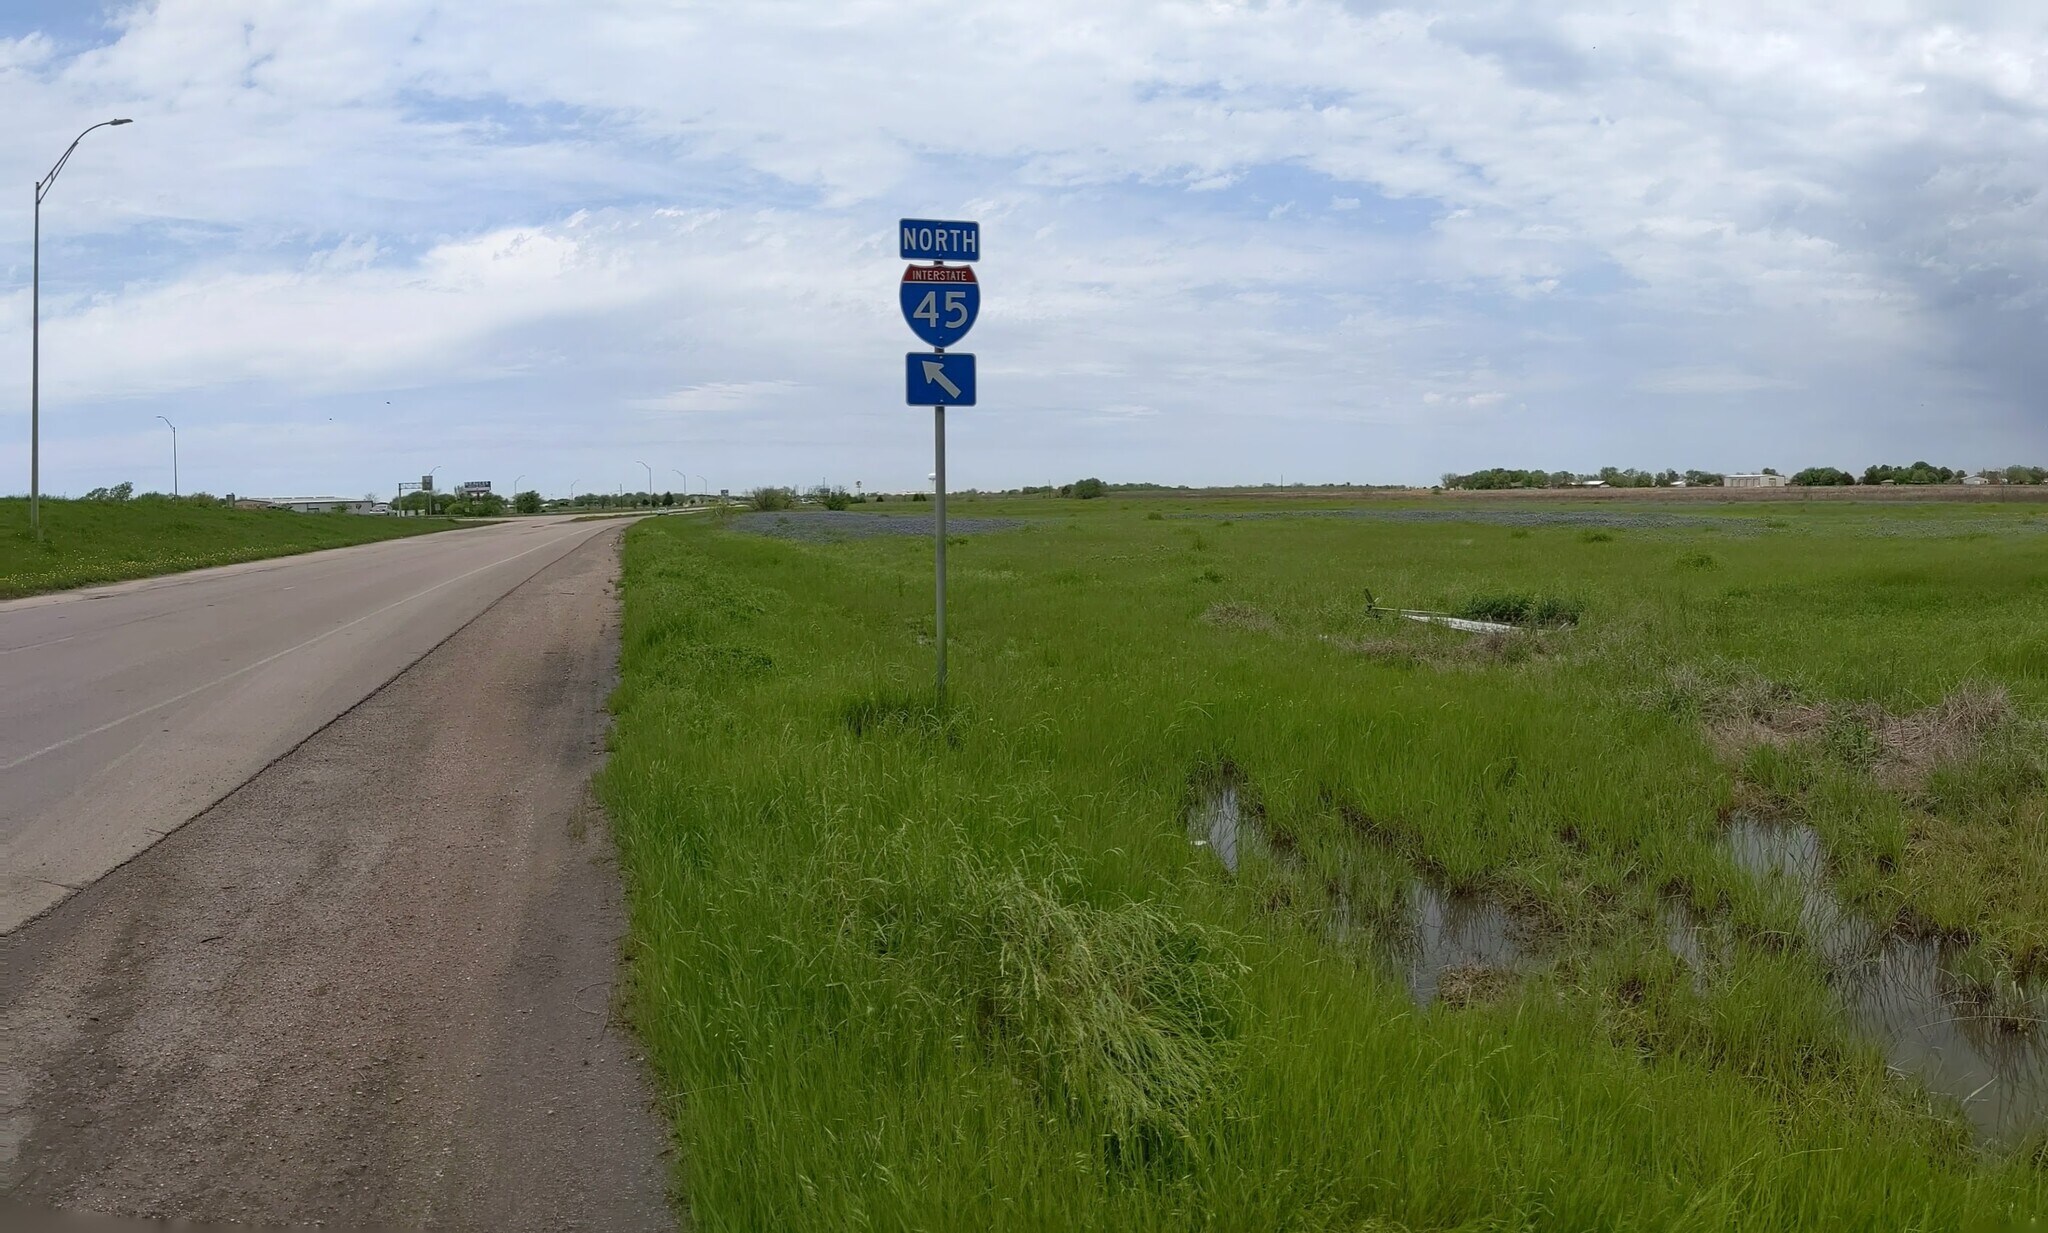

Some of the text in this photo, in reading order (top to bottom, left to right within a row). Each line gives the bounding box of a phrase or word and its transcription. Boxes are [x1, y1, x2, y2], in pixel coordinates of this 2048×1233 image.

[903, 228, 976, 253] NORTH
[912, 270, 967, 281] INTERSTATE
[912, 291, 969, 329] 45
